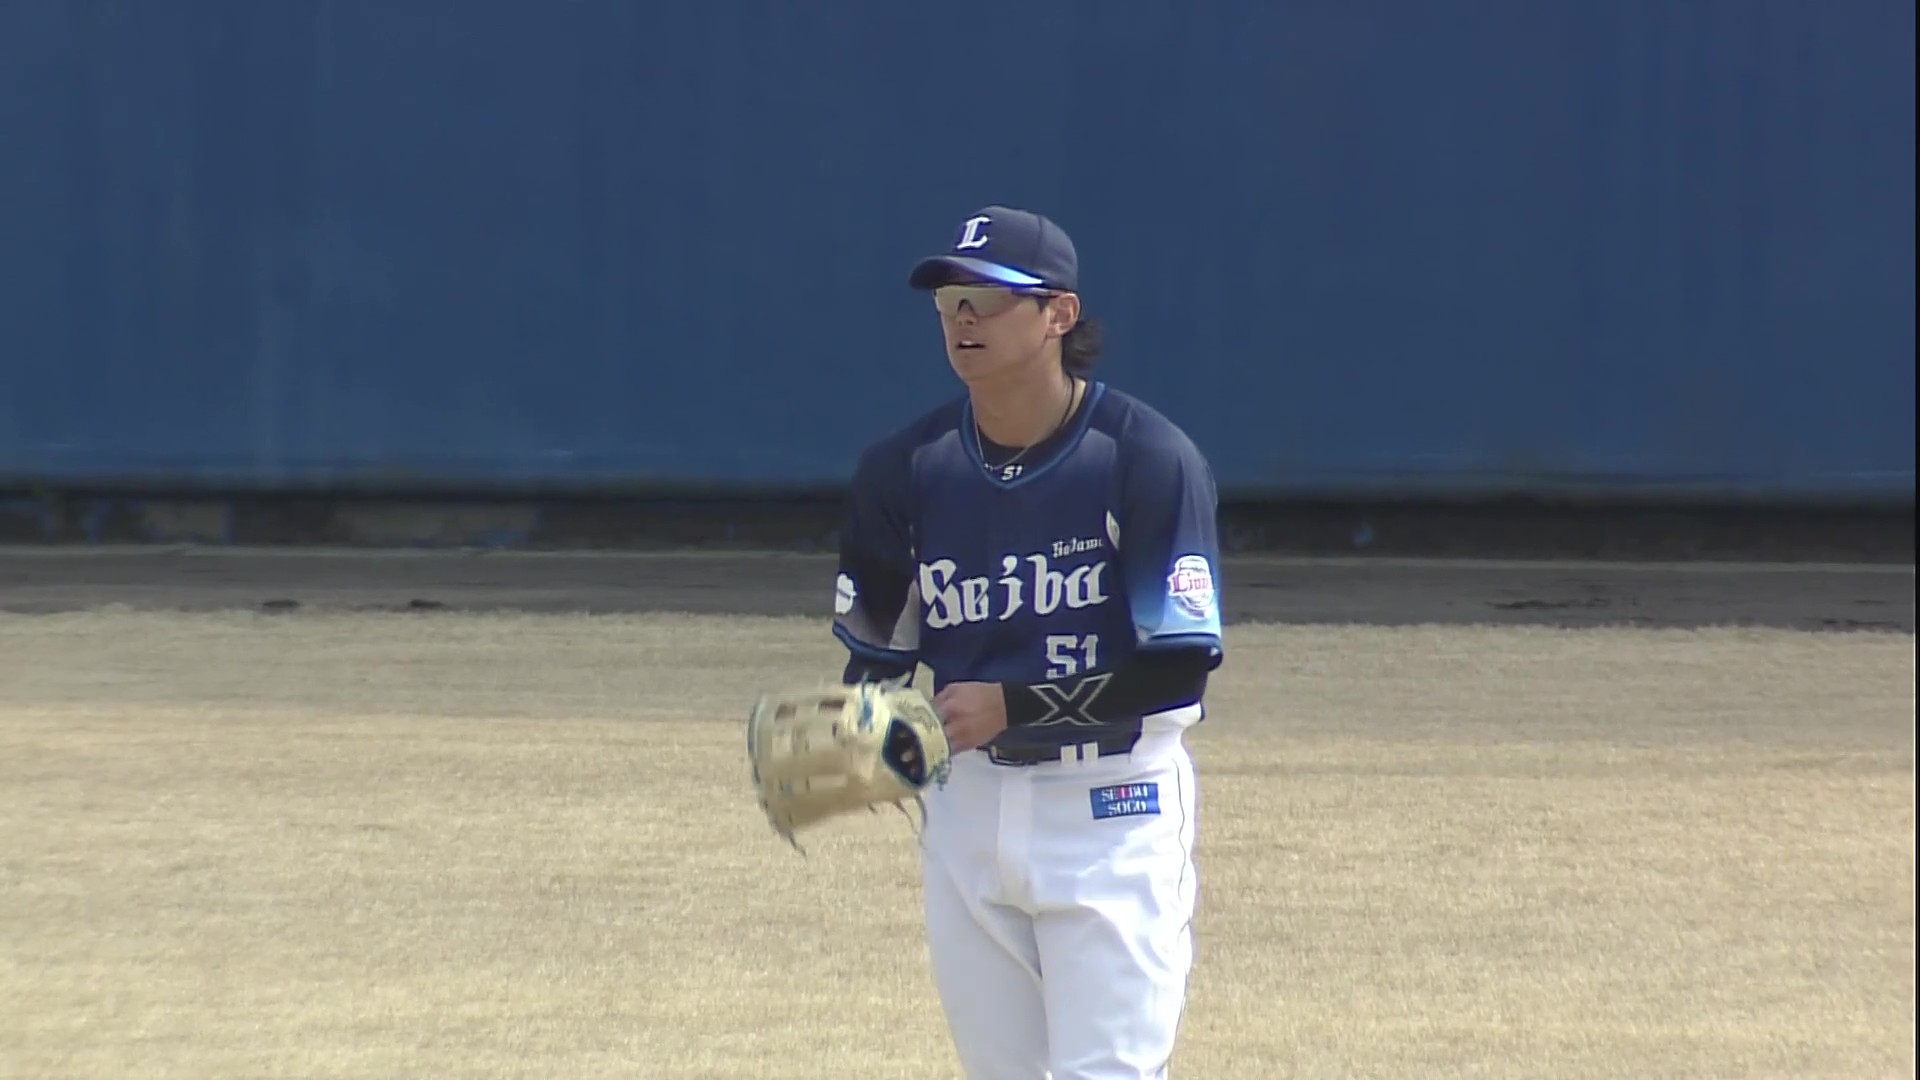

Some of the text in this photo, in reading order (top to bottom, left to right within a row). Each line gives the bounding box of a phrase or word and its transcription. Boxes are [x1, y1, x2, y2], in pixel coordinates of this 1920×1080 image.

[957, 216, 991, 249] L
[1001, 465, 1023, 480] 51
[919, 555, 1109, 629] Seibu
[1046, 634, 1098, 679] 51
